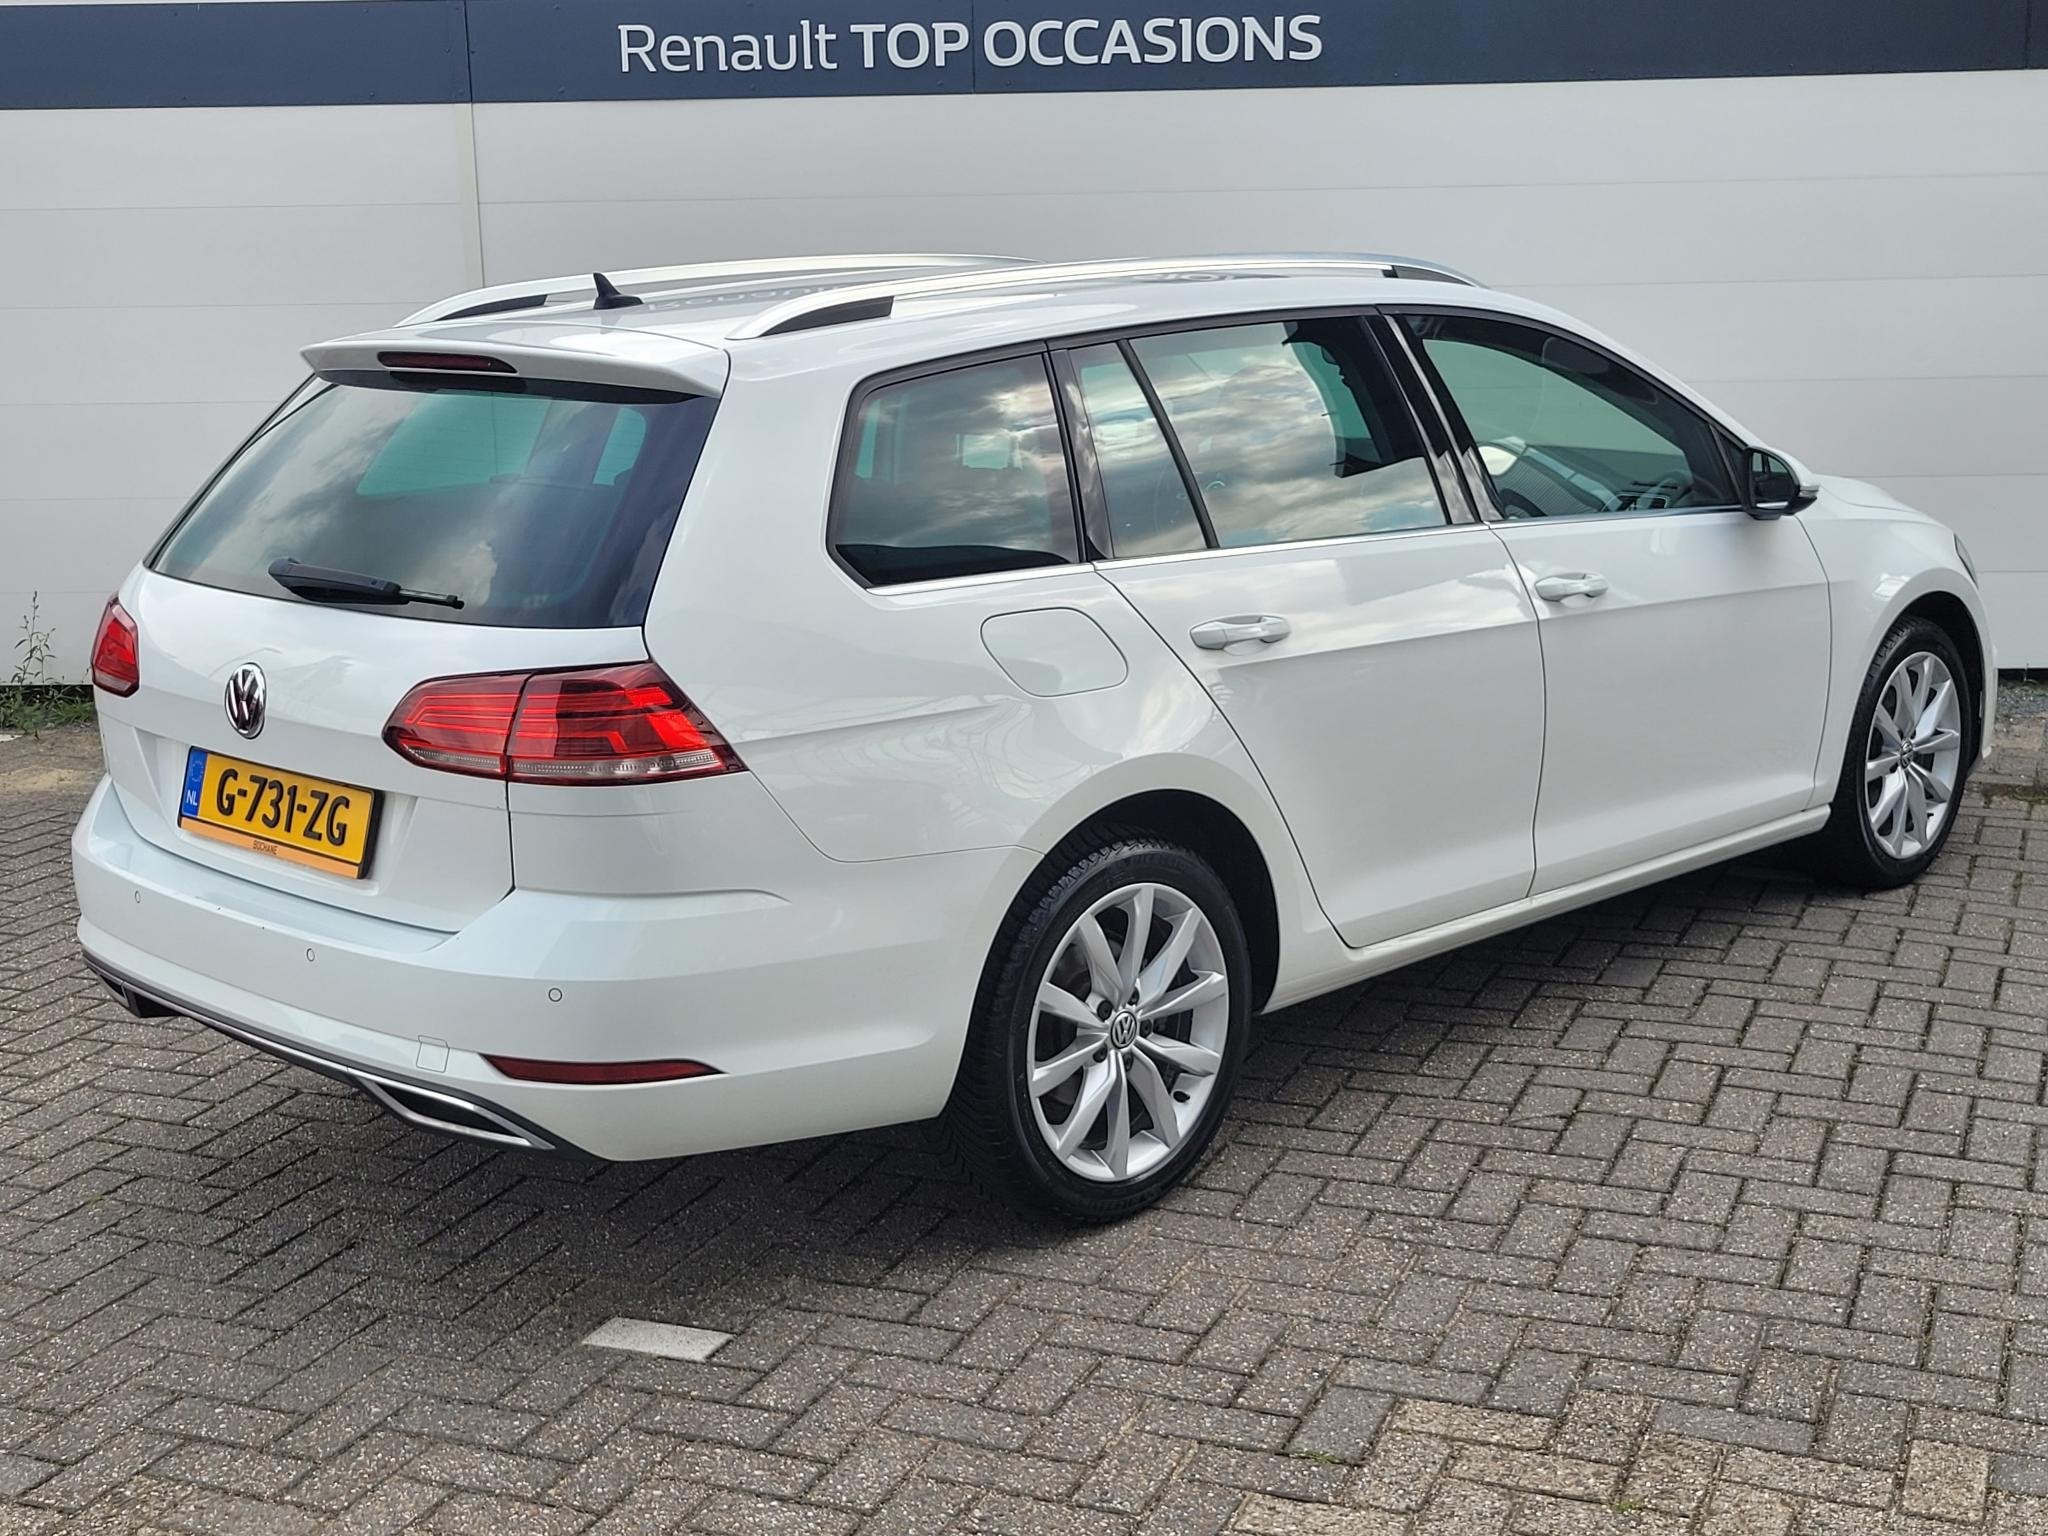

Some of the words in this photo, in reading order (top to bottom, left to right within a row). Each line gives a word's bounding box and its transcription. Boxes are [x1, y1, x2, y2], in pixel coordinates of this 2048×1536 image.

[617, 19, 838, 73] Renault
[849, 22, 970, 69] TOP
[983, 14, 1323, 67] OCCASIONS
[186, 789, 198, 807] NL
[216, 768, 350, 847] G-731-ZG
